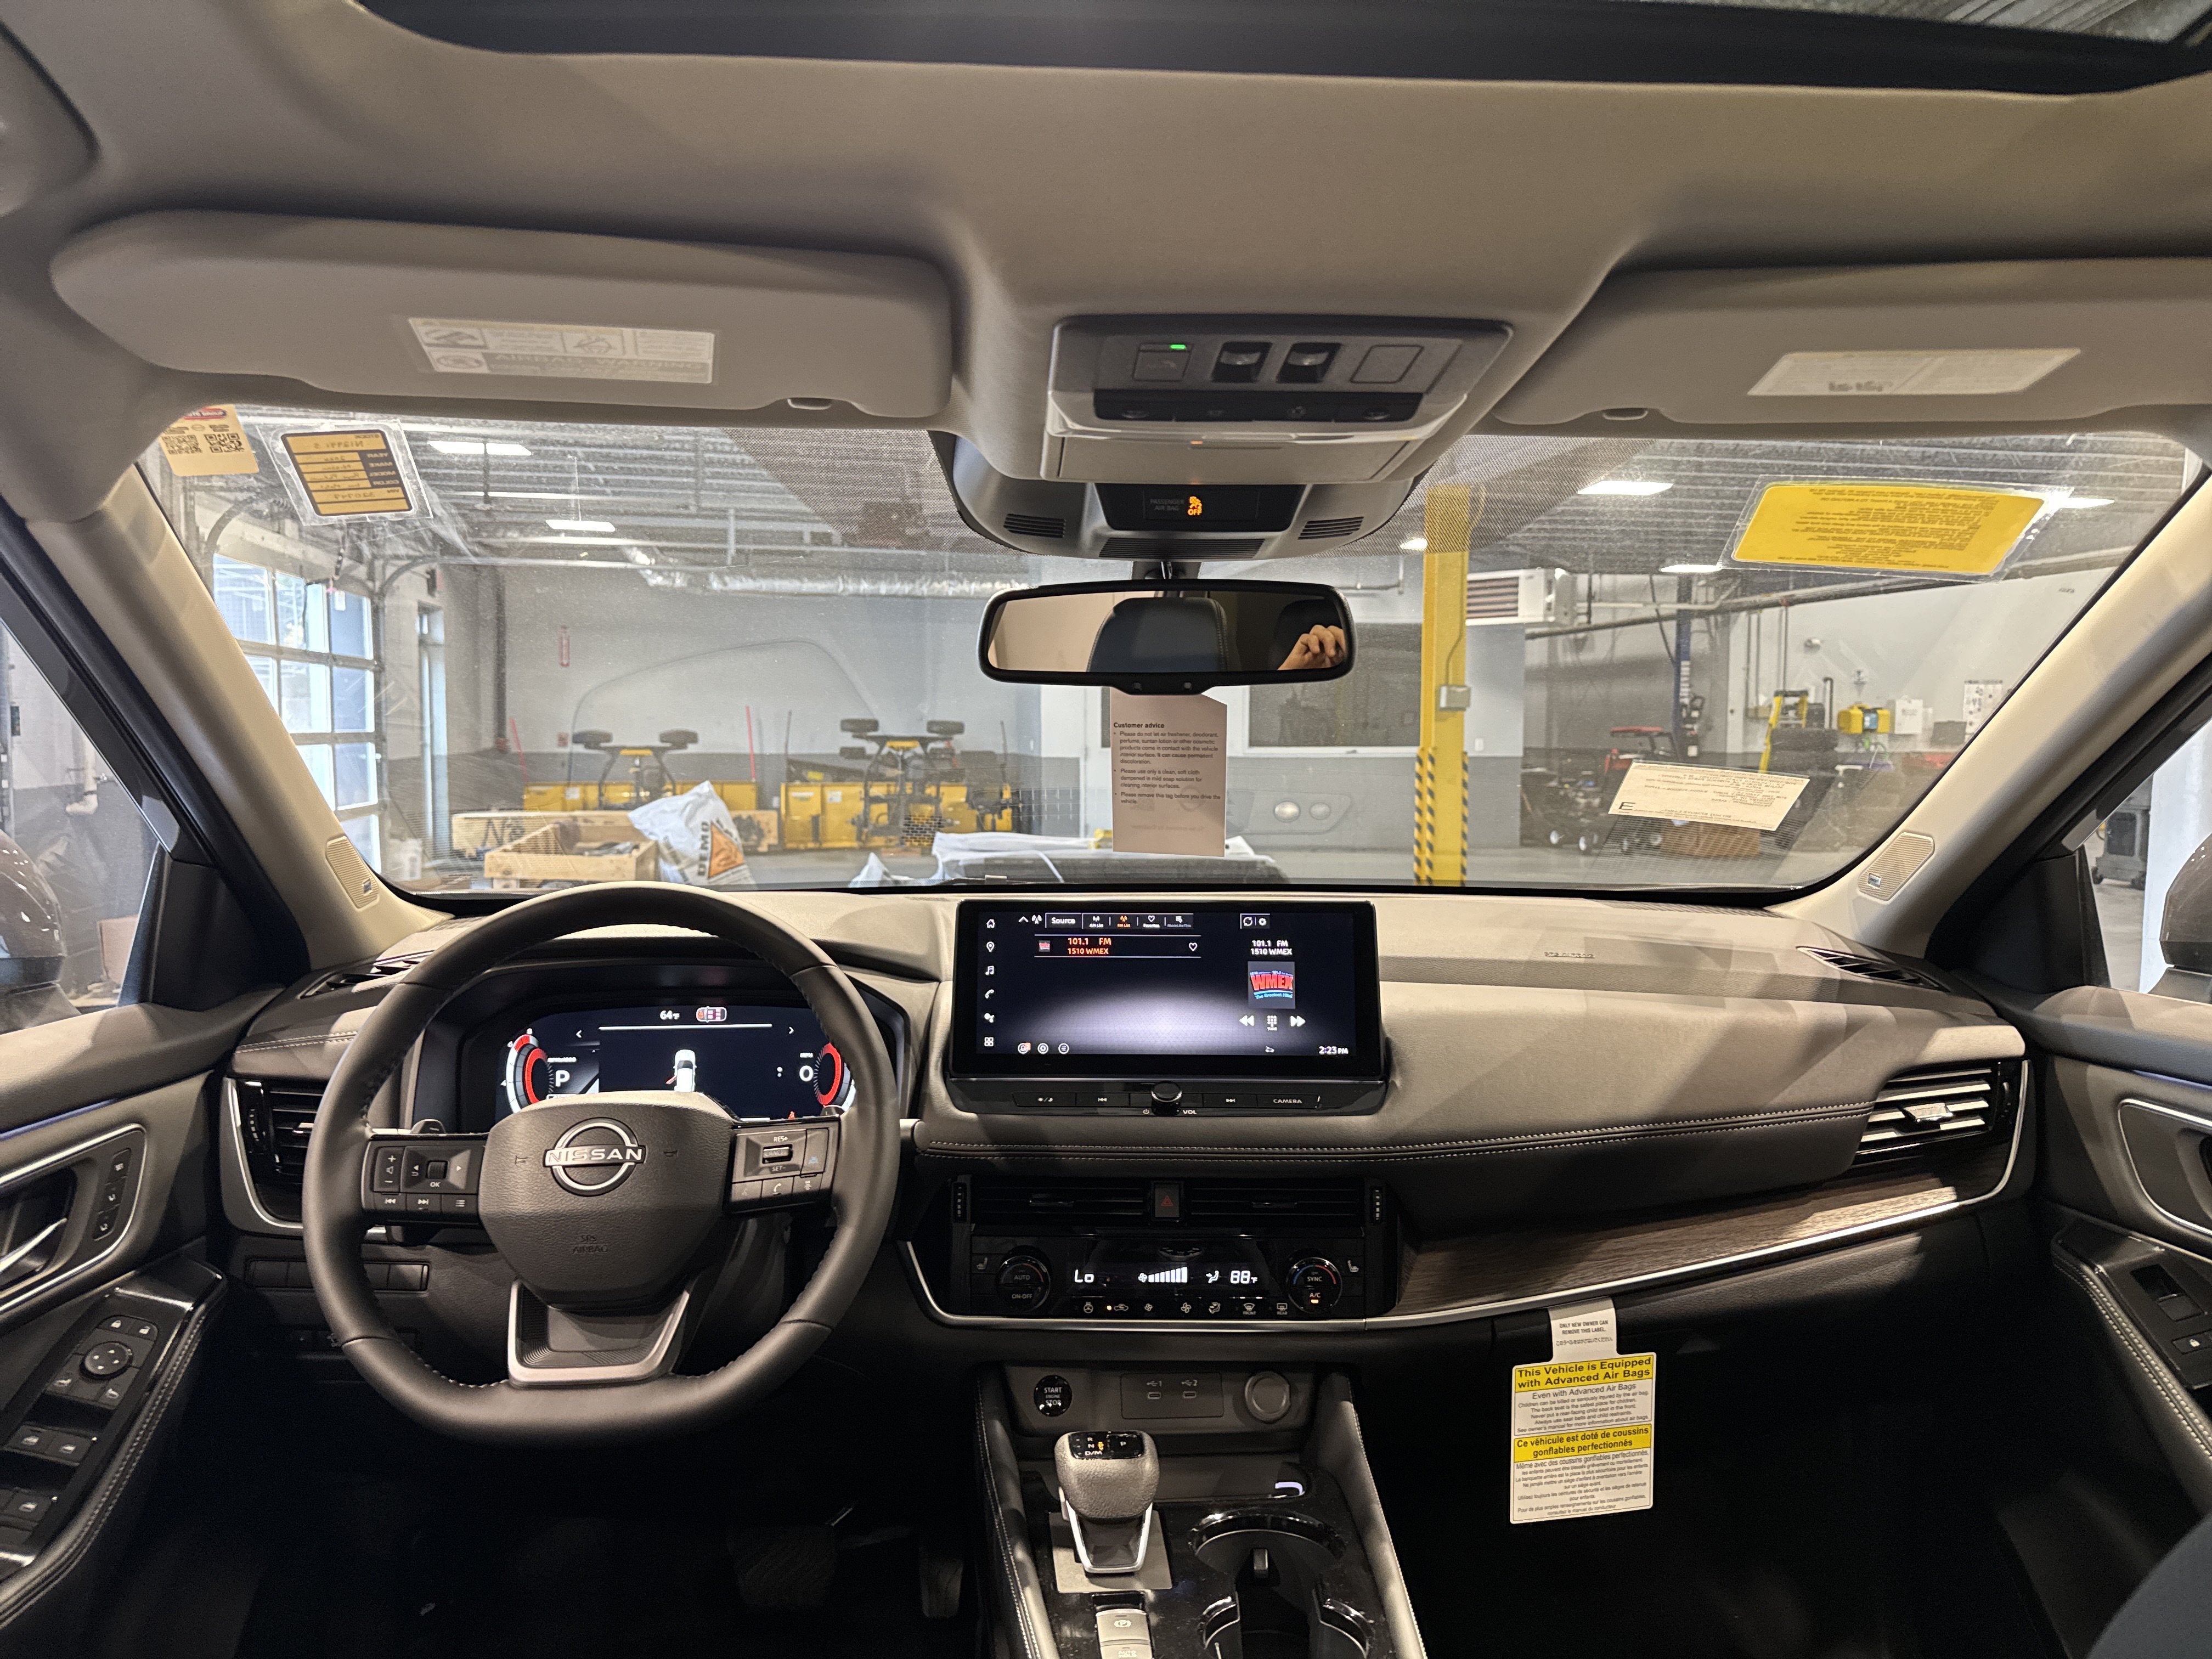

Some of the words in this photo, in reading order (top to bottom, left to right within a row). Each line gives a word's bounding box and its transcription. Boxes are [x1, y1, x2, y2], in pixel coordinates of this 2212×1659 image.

[1618, 802, 1636, 810] E
[1250, 974, 1294, 991] WMEX
[1319, 1046, 1337, 1055] 2:23
[555, 1070, 570, 1087] P
[548, 1148, 643, 1163] NISSAN
[581, 1234, 597, 1243] SRS
[572, 1245, 608, 1254] AIRBAG
[1074, 1269, 1094, 1283] Lo
[1518, 1368, 1541, 1378] This
[1544, 1364, 1584, 1375] Vehicle
[1587, 1363, 1597, 1372] is
[1600, 1357, 1651, 1370] Equipped
[1518, 1379, 1541, 1389] with
[1544, 1373, 1599, 1386] Advanced
[1603, 1370, 1619, 1380] Air
[1623, 1368, 1650, 1378] Bags
[1569, 1386, 1604, 1396] Advanced
[1517, 1439, 1528, 1448] Ce
[1530, 1435, 1564, 1447] véhicule
[1566, 1434, 1579, 1443] est
[1581, 1431, 1599, 1441] doté
[1602, 1429, 1611, 1438] de
[1612, 1426, 1649, 1437] coussins
[1533, 1446, 1576, 1459] gonflables
[1577, 1439, 1633, 1454] perfectionnés
